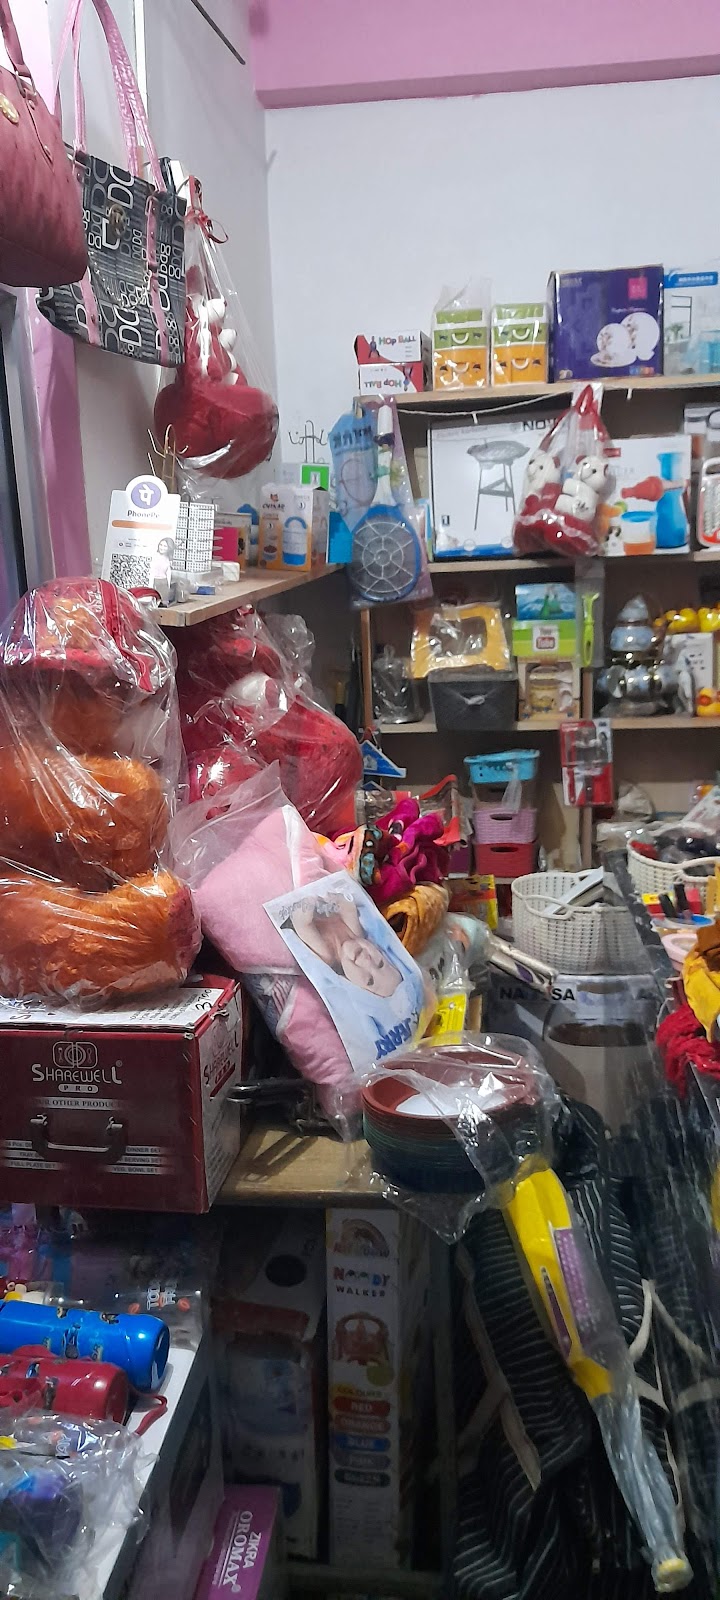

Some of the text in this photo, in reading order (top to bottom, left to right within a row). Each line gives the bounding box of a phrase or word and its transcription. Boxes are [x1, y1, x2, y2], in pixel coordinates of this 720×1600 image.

[398, 333, 416, 344] BALL
[364, 380, 382, 389] BALL
[127, 509, 160, 519] PhonePe
[375, 1017, 412, 1061] JERRY
[31, 1063, 123, 1085] SHAREWELL
[52, 1099, 80, 1107] OTHER
[335, 1284, 386, 1298] WALKER
[350, 1401, 373, 1412] RED
[222, 1510, 253, 1586] OROMAX
[242, 1531, 262, 1569] ZIKRA
